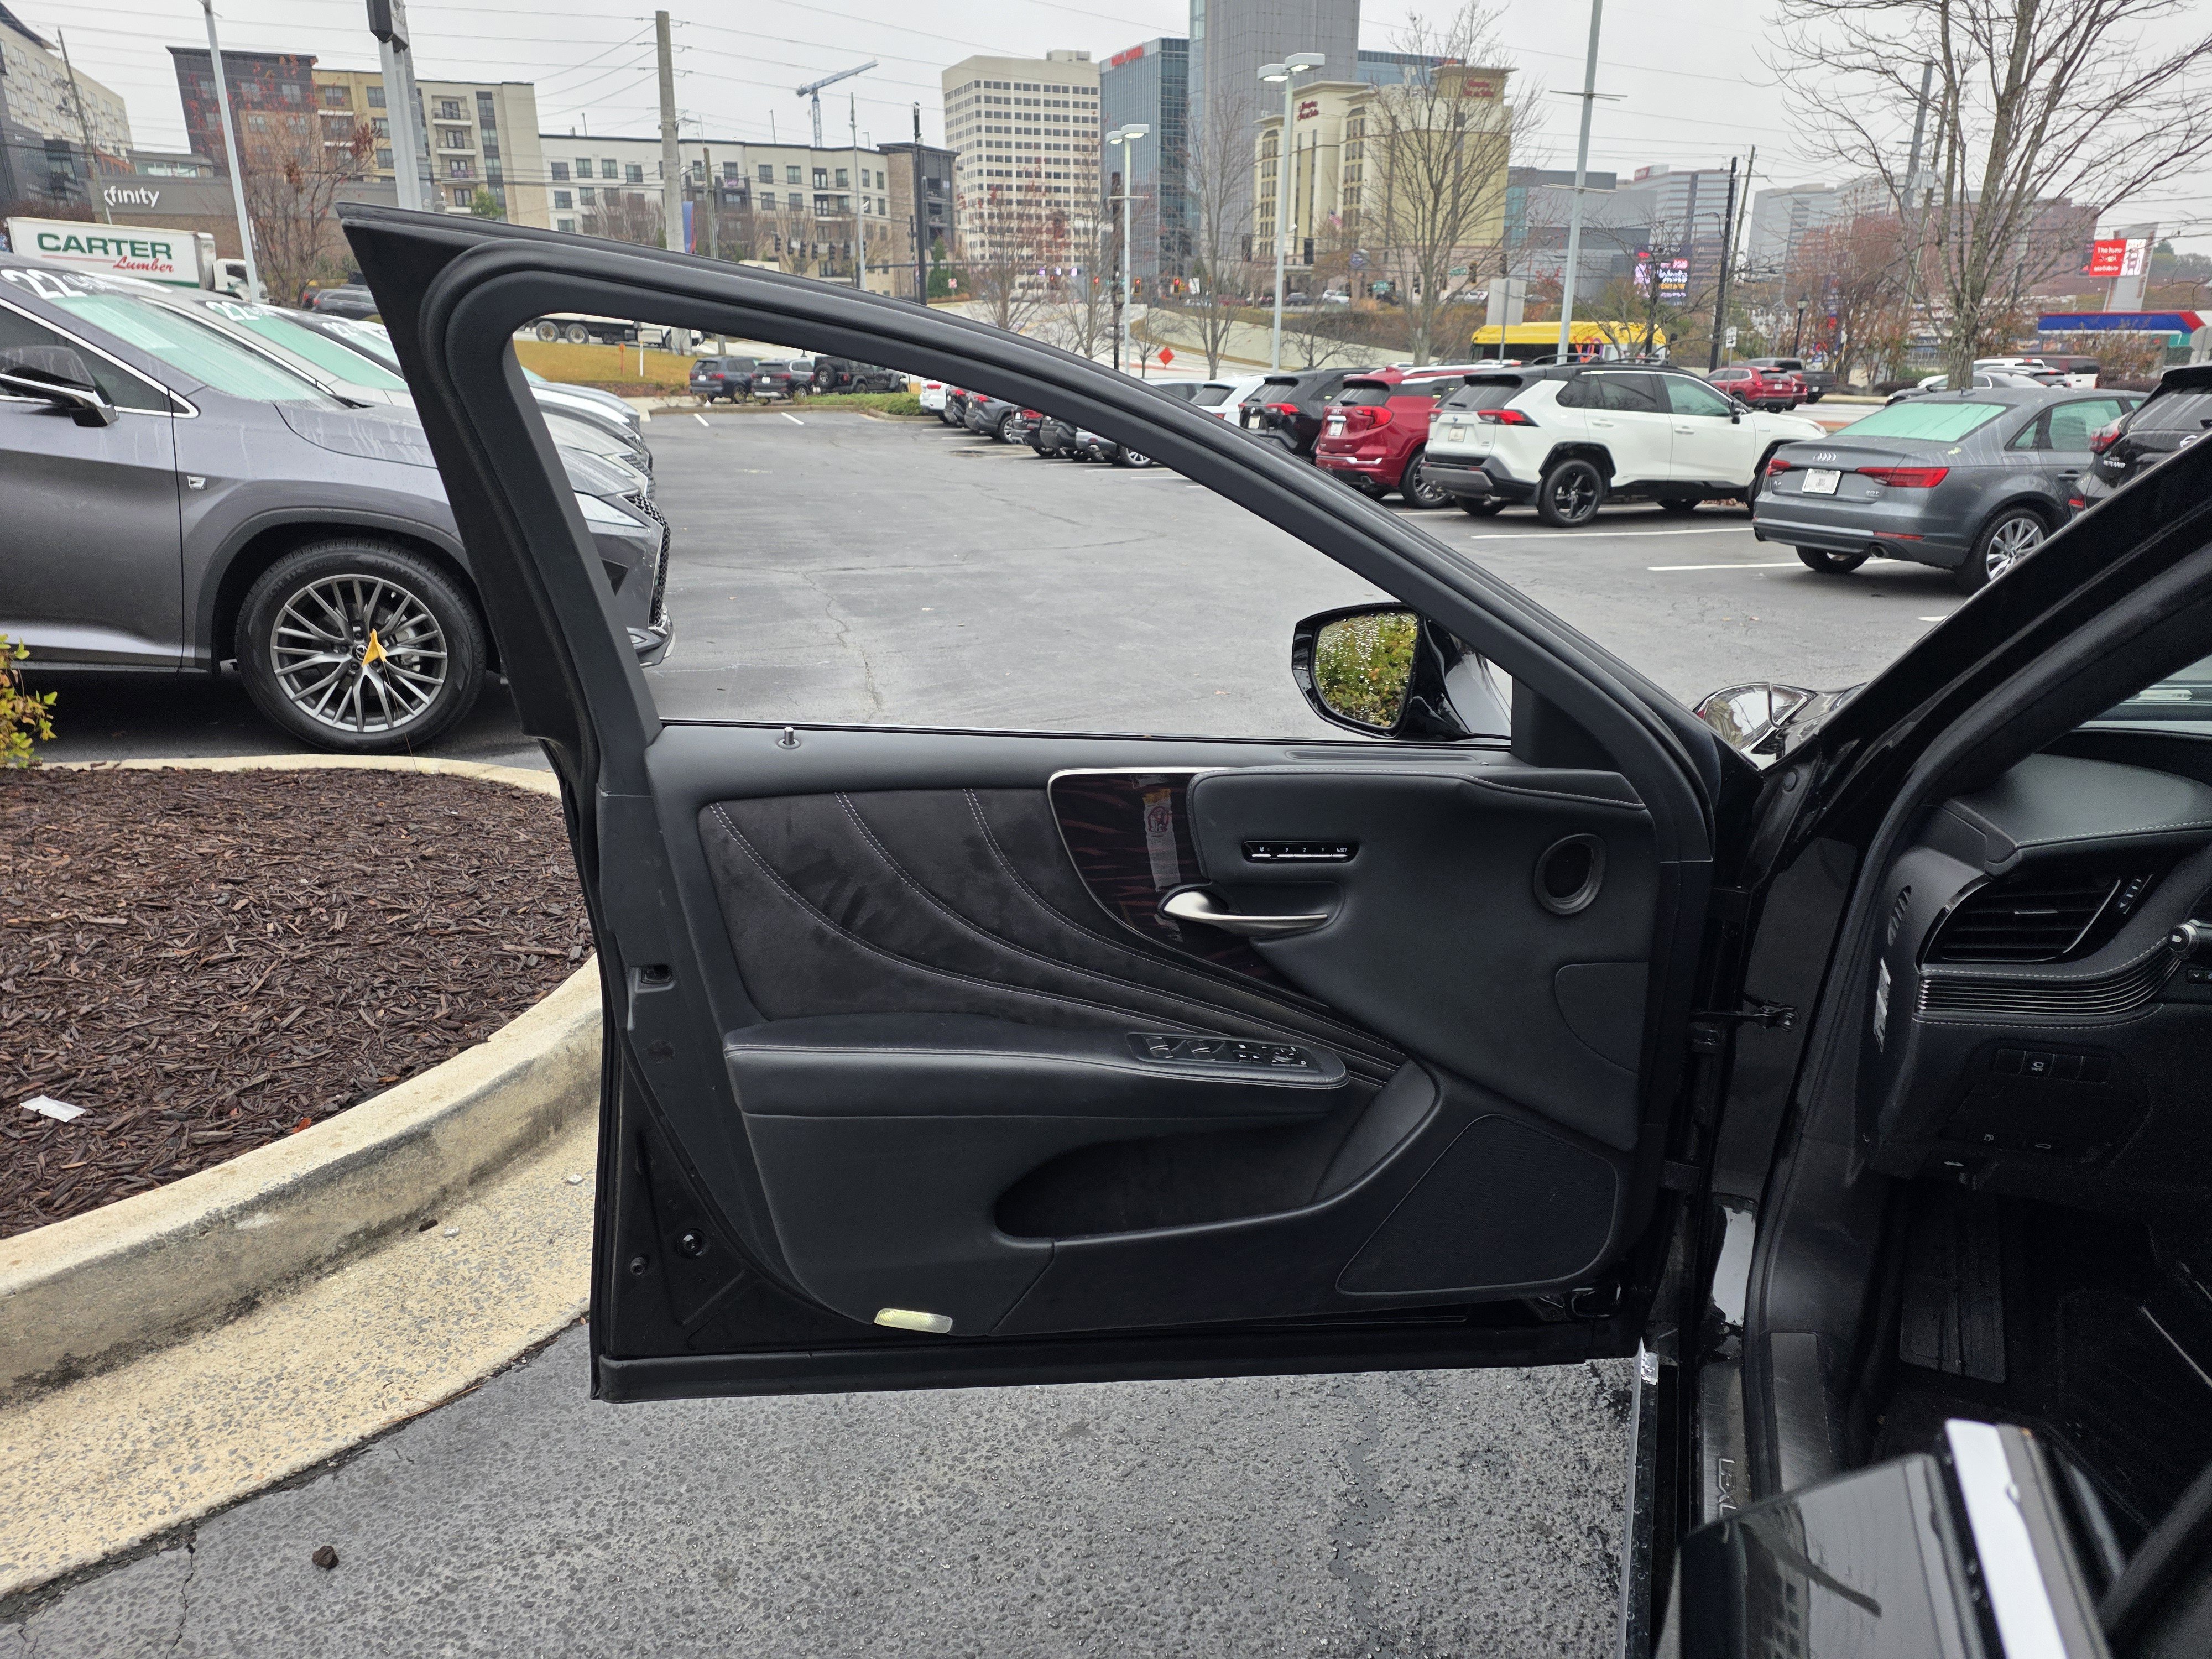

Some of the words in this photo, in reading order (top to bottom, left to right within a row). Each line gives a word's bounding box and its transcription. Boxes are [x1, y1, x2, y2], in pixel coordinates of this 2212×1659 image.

[37, 233, 173, 259] CARTER
[113, 255, 174, 273] Lumber
[1, 269, 88, 299] 22
[206, 301, 260, 321] 22
